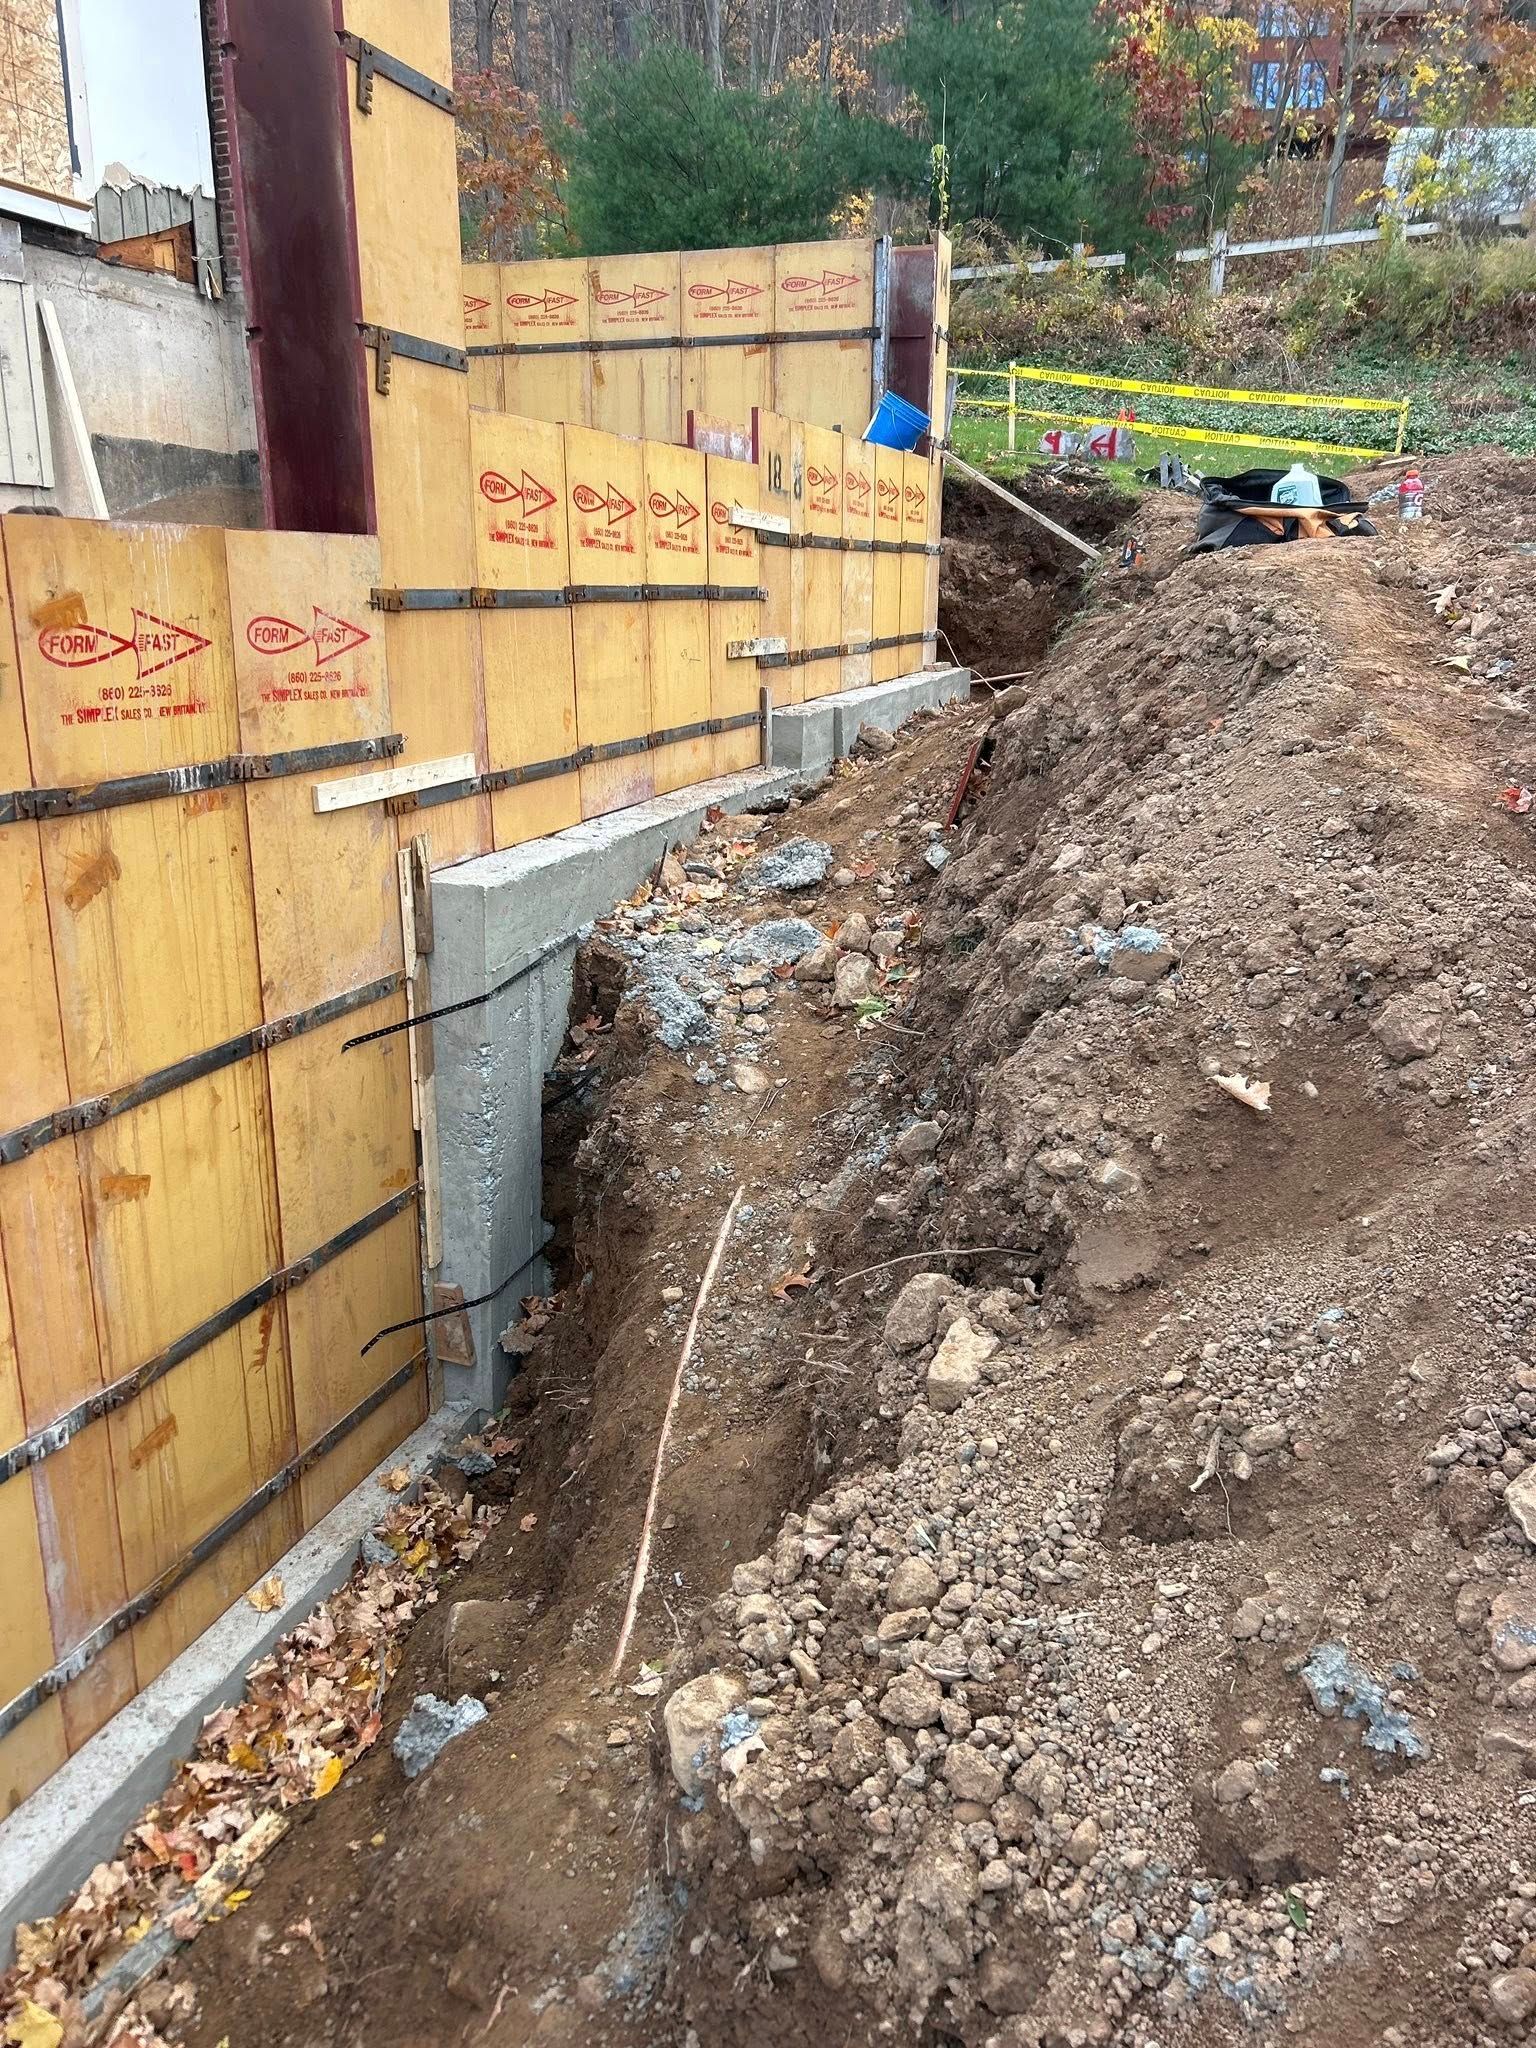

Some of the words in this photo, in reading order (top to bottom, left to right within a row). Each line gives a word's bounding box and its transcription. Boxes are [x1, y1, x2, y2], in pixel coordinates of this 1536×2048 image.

[786, 280, 808, 288] FORM
[827, 277, 845, 286] FAST
[637, 291, 654, 299] FAST
[691, 288, 712, 296] FORM
[731, 287, 749, 295] FAST
[511, 297, 531, 305] FORM
[547, 296, 564, 304] FAST
[484, 479, 507, 495] FORM
[525, 487, 542, 502] FAST
[610, 498, 625, 511] FAST
[652, 499, 667, 511] FORM
[679, 504, 691, 516] FAST
[714, 507, 727, 519] FORM
[254, 627, 289, 643] FORM
[321, 627, 348, 643] FAST
[50, 634, 98, 654] FORM
[144, 634, 180, 652] FAST
[261, 693, 271, 703] THE
[272, 688, 303, 702] SIMPLEX
[303, 690, 319, 701] SALES
[61, 714, 74, 726] THE
[120, 708, 142, 720] SALES
